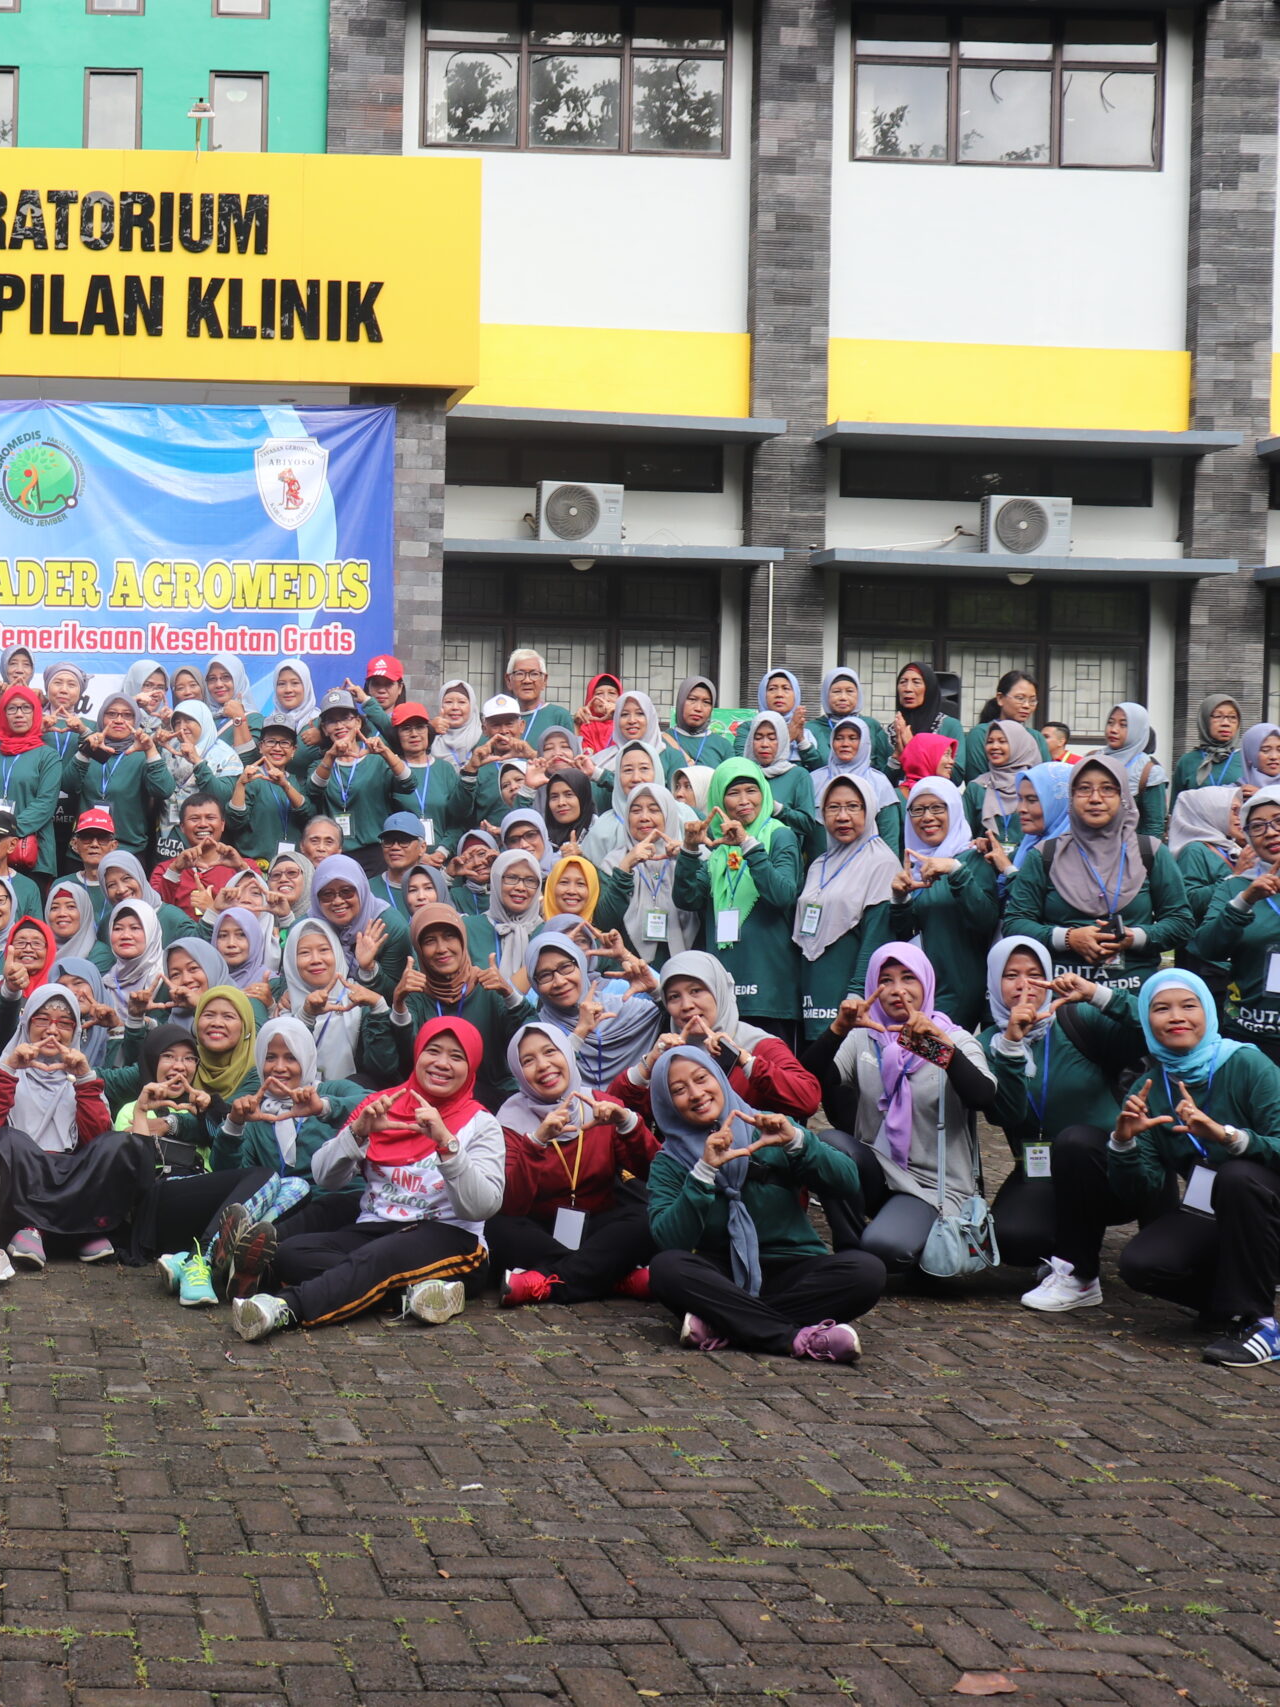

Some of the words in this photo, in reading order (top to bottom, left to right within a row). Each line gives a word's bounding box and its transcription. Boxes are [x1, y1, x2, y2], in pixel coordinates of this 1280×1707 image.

[186, 277, 383, 343] KLINIK
[36, 512, 68, 527] JEMBER
[109, 561, 369, 610] AGROMEDIS
[151, 624, 277, 653] Kesehatan
[284, 624, 353, 652] Gratis
[157, 837, 185, 851] DUTA
[1240, 1006, 1280, 1024] DUT
[391, 1167, 423, 1193] AND
